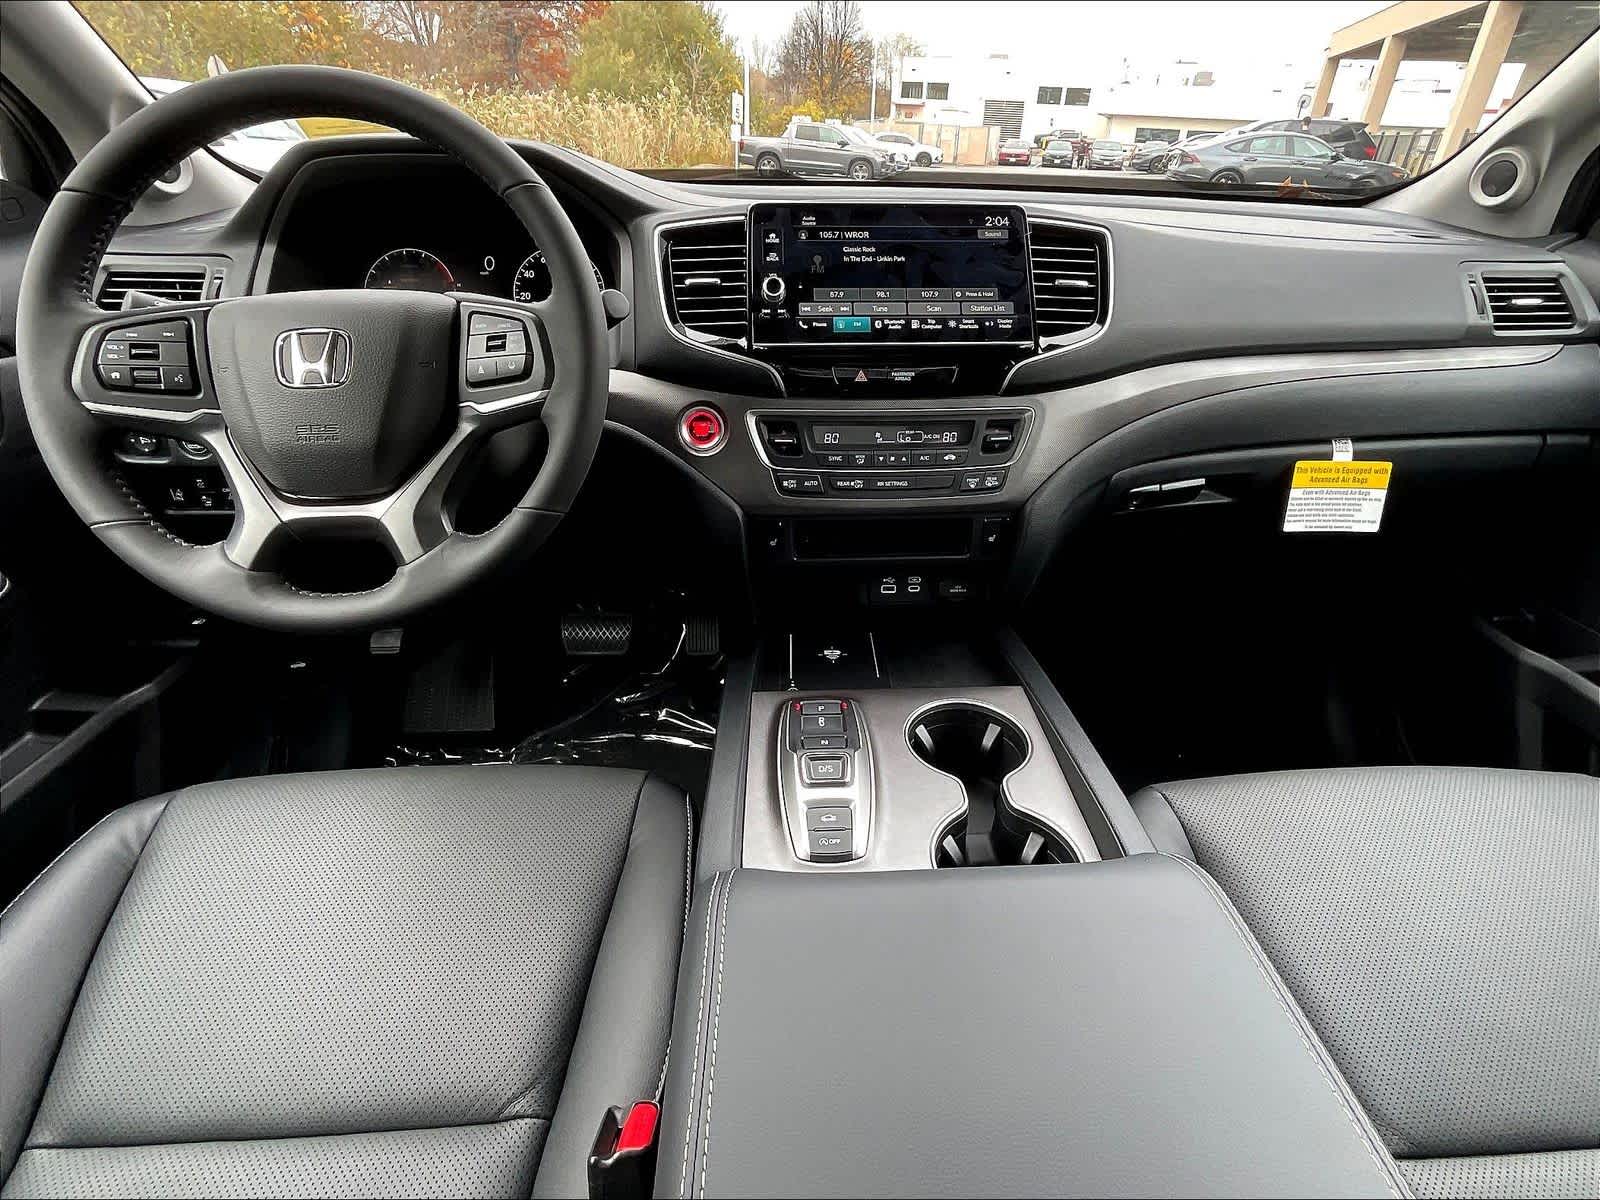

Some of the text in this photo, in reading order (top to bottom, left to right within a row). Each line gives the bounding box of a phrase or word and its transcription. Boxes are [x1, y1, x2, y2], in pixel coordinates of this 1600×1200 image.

[984, 216, 1010, 227] 2:04
[819, 231, 840, 239] 105.7
[844, 231, 870, 239] WROR
[523, 270, 535, 279] 40
[520, 292, 531, 301] 20
[829, 290, 844, 298] 87.9
[876, 290, 890, 298] 98.1
[921, 290, 939, 298] 107.9
[818, 304, 834, 312] Seek
[872, 304, 888, 312] Tune
[926, 304, 942, 312] Scan
[970, 303, 1006, 311] Station List
[823, 432, 840, 444] 80
[942, 431, 958, 443] 80
[828, 455, 843, 463] SYNC
[1296, 466, 1389, 475] This Vehicle is Equipped with
[1309, 476, 1369, 485] Advanced Air Bags
[818, 764, 834, 774] D/S
